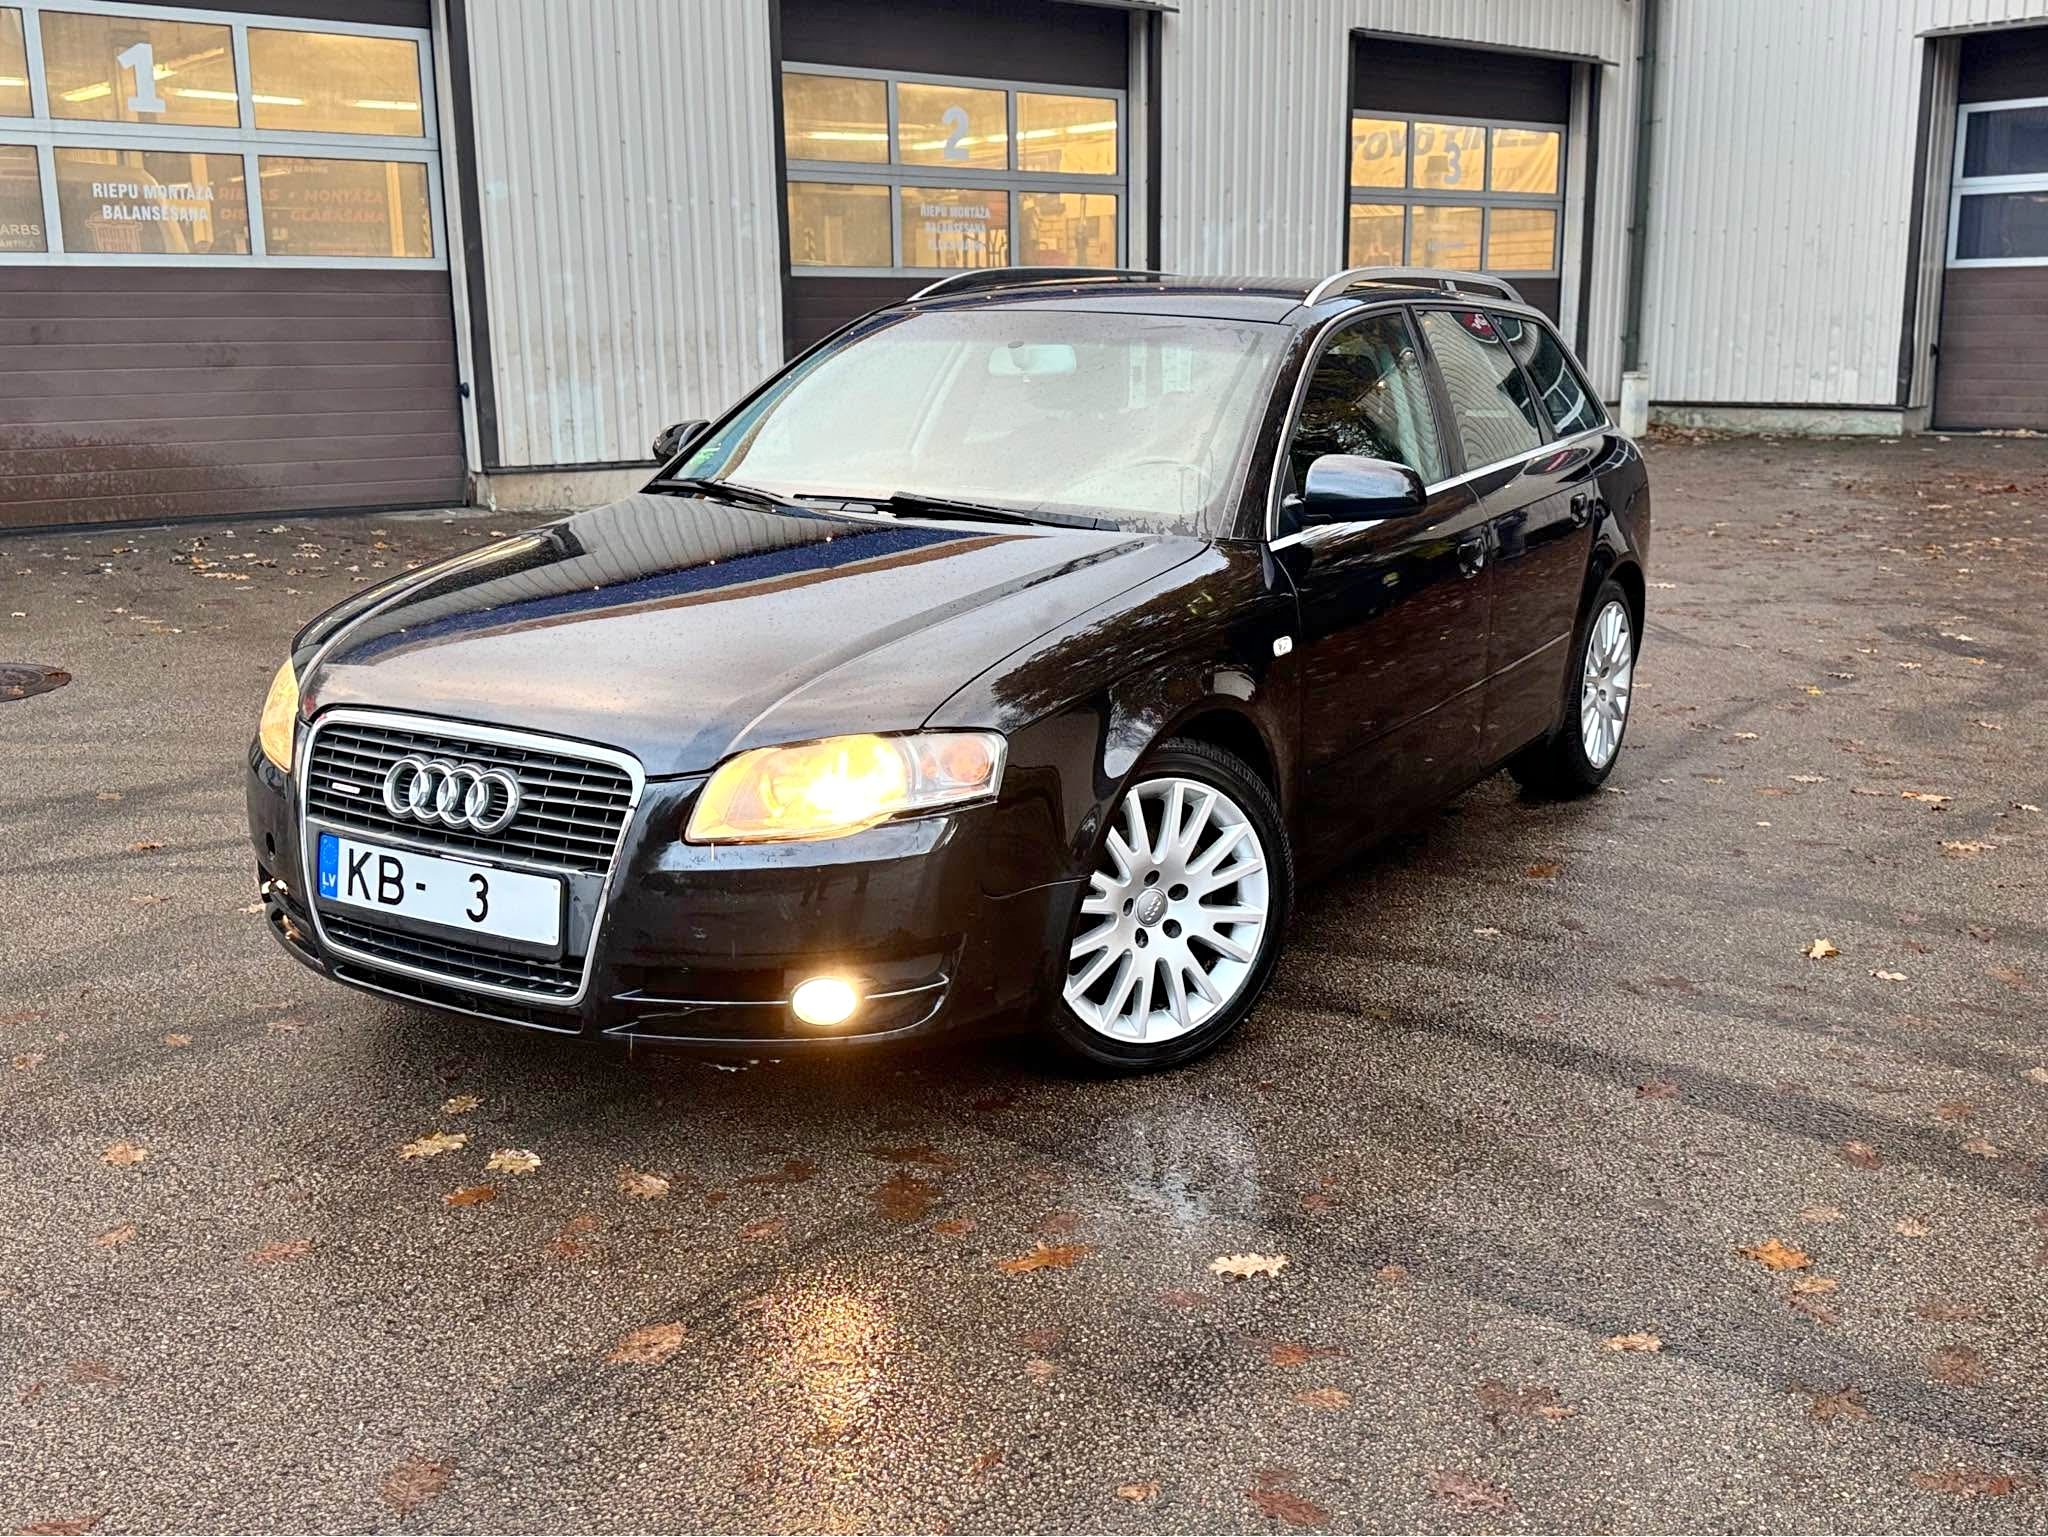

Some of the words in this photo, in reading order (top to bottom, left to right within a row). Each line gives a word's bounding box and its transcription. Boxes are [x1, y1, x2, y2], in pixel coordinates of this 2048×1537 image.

[116, 42, 166, 113] 1
[942, 105, 970, 161] 2
[1443, 141, 1462, 185] 3
[92, 182, 139, 199] RIEPU
[321, 871, 336, 888] LV
[465, 872, 489, 923] 3
